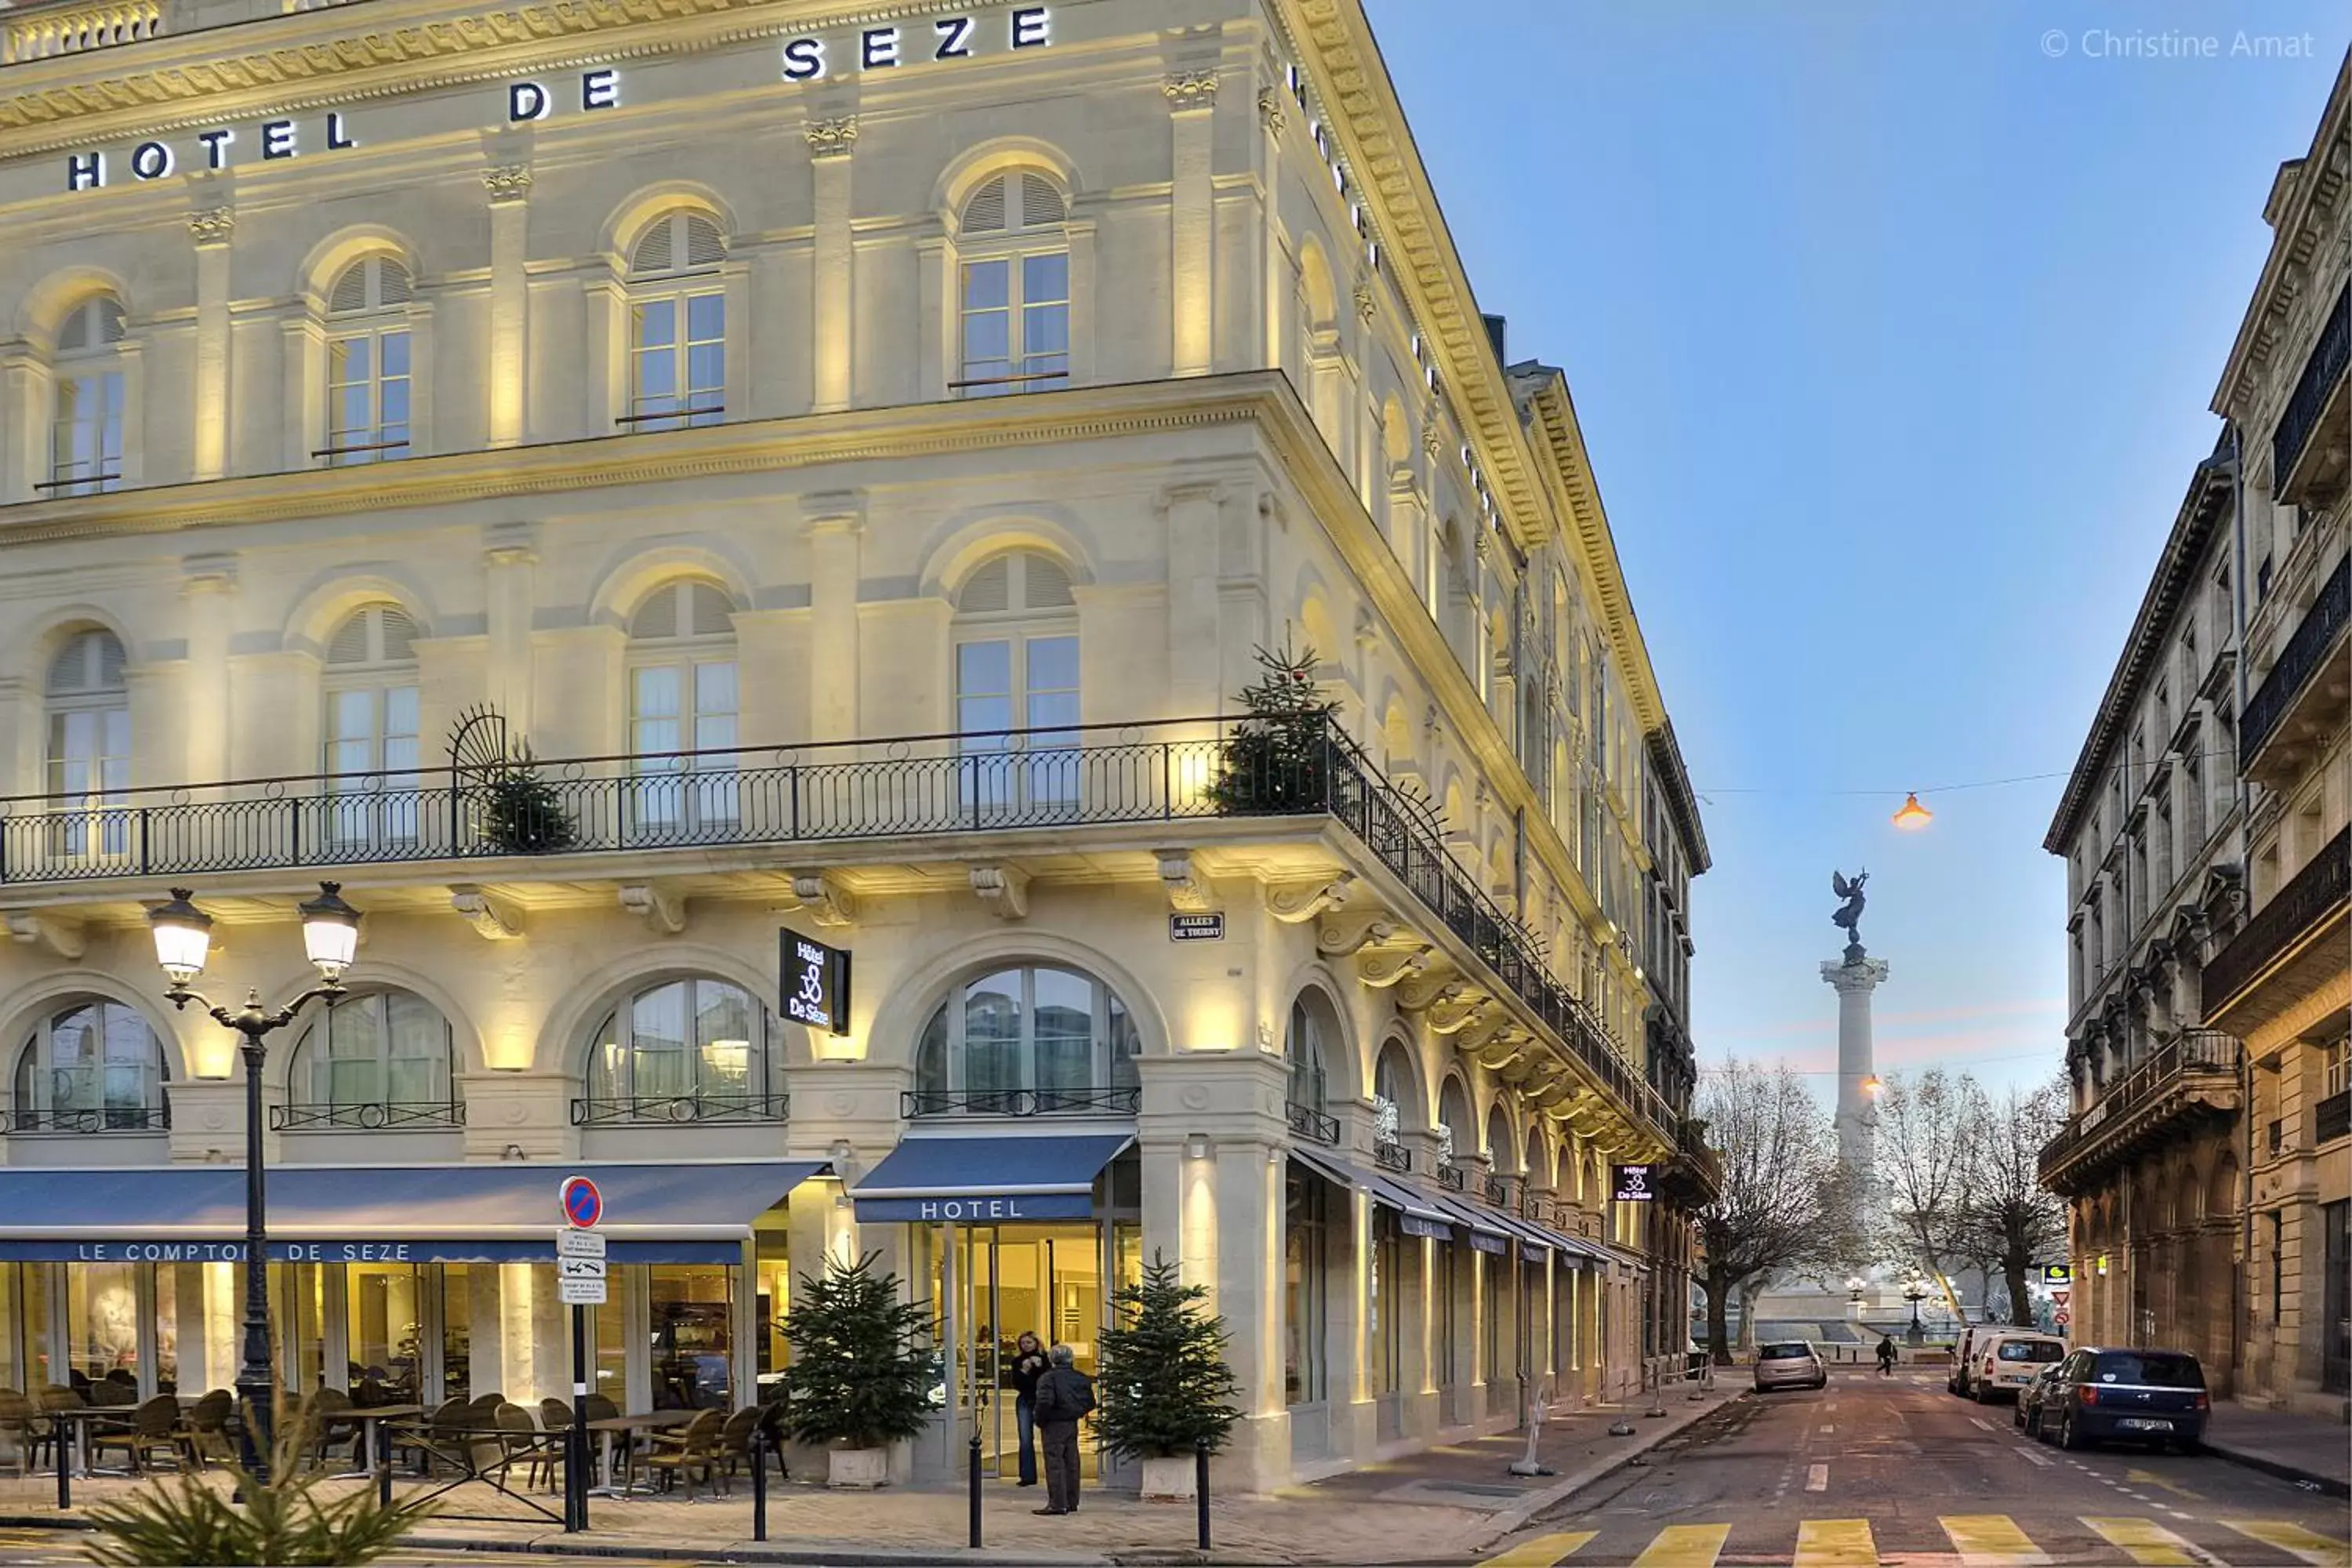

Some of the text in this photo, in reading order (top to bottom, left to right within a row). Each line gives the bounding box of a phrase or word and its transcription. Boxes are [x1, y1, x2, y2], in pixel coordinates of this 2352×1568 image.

[68, 7, 1051, 191] HOTEL DE SEZE
[789, 996, 806, 1018] De
[921, 1200, 1023, 1219] HOTEL
[79, 1243, 409, 1261] LE COMPTOI DE SEZE
